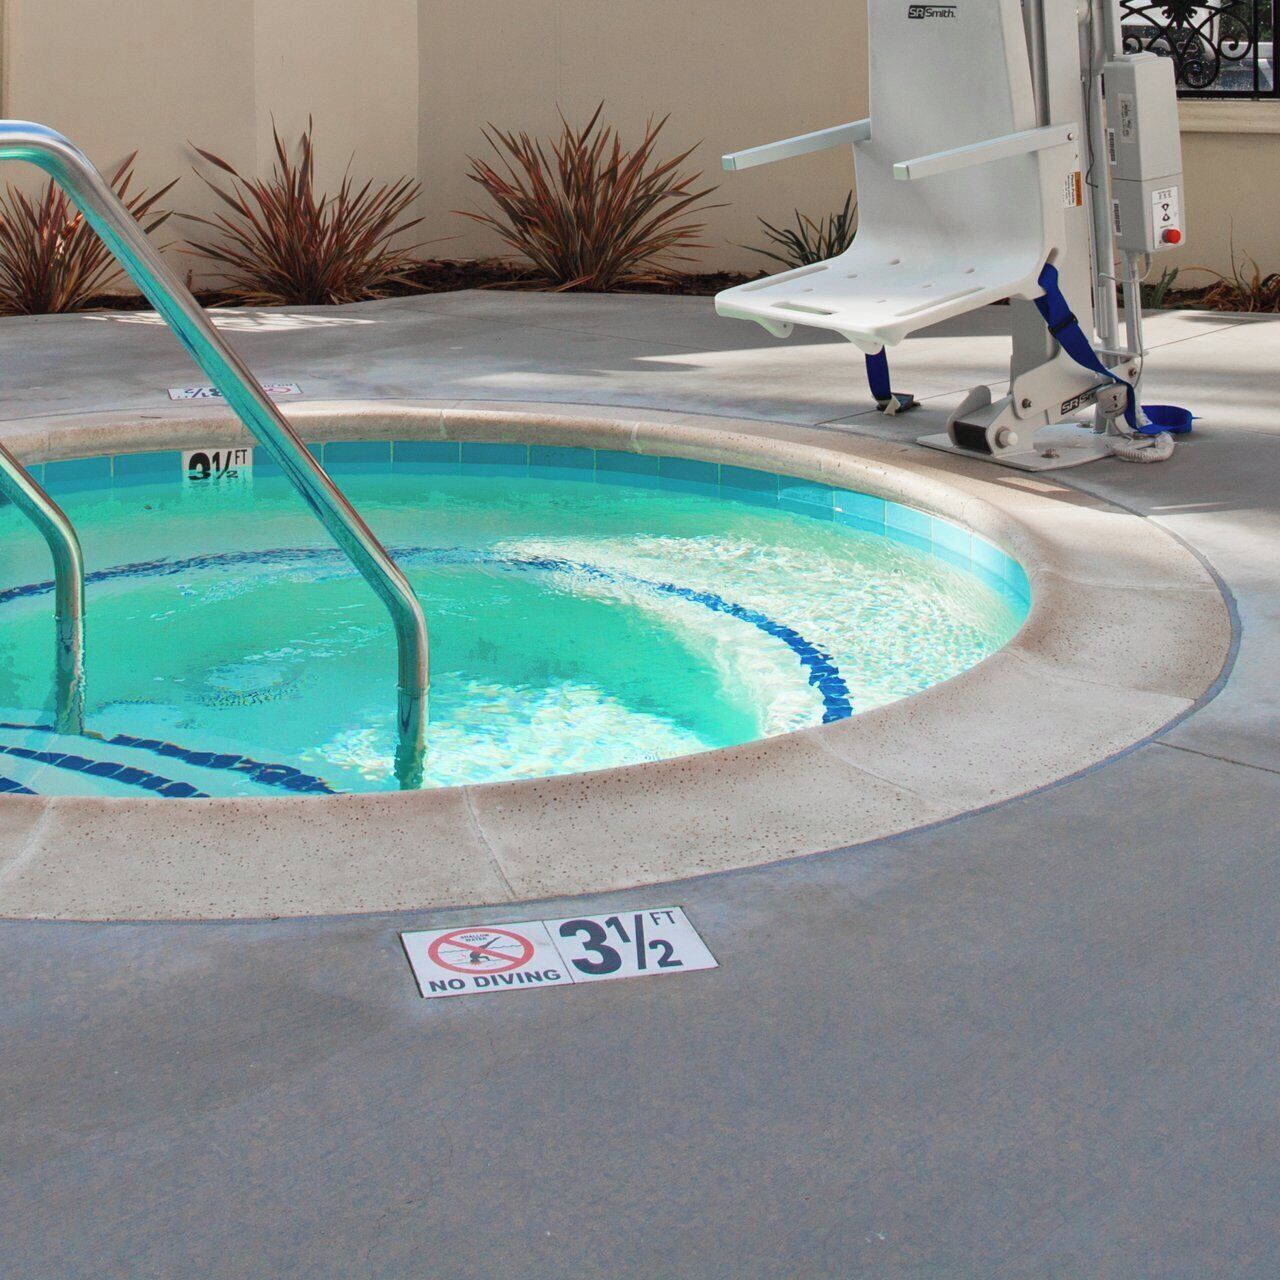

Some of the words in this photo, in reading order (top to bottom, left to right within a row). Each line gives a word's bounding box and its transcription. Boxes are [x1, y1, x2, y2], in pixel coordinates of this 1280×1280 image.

[235, 449, 247, 465] FT
[649, 910, 675, 926] FT
[429, 977, 466, 993] NO
[476, 969, 561, 988] DIVING
